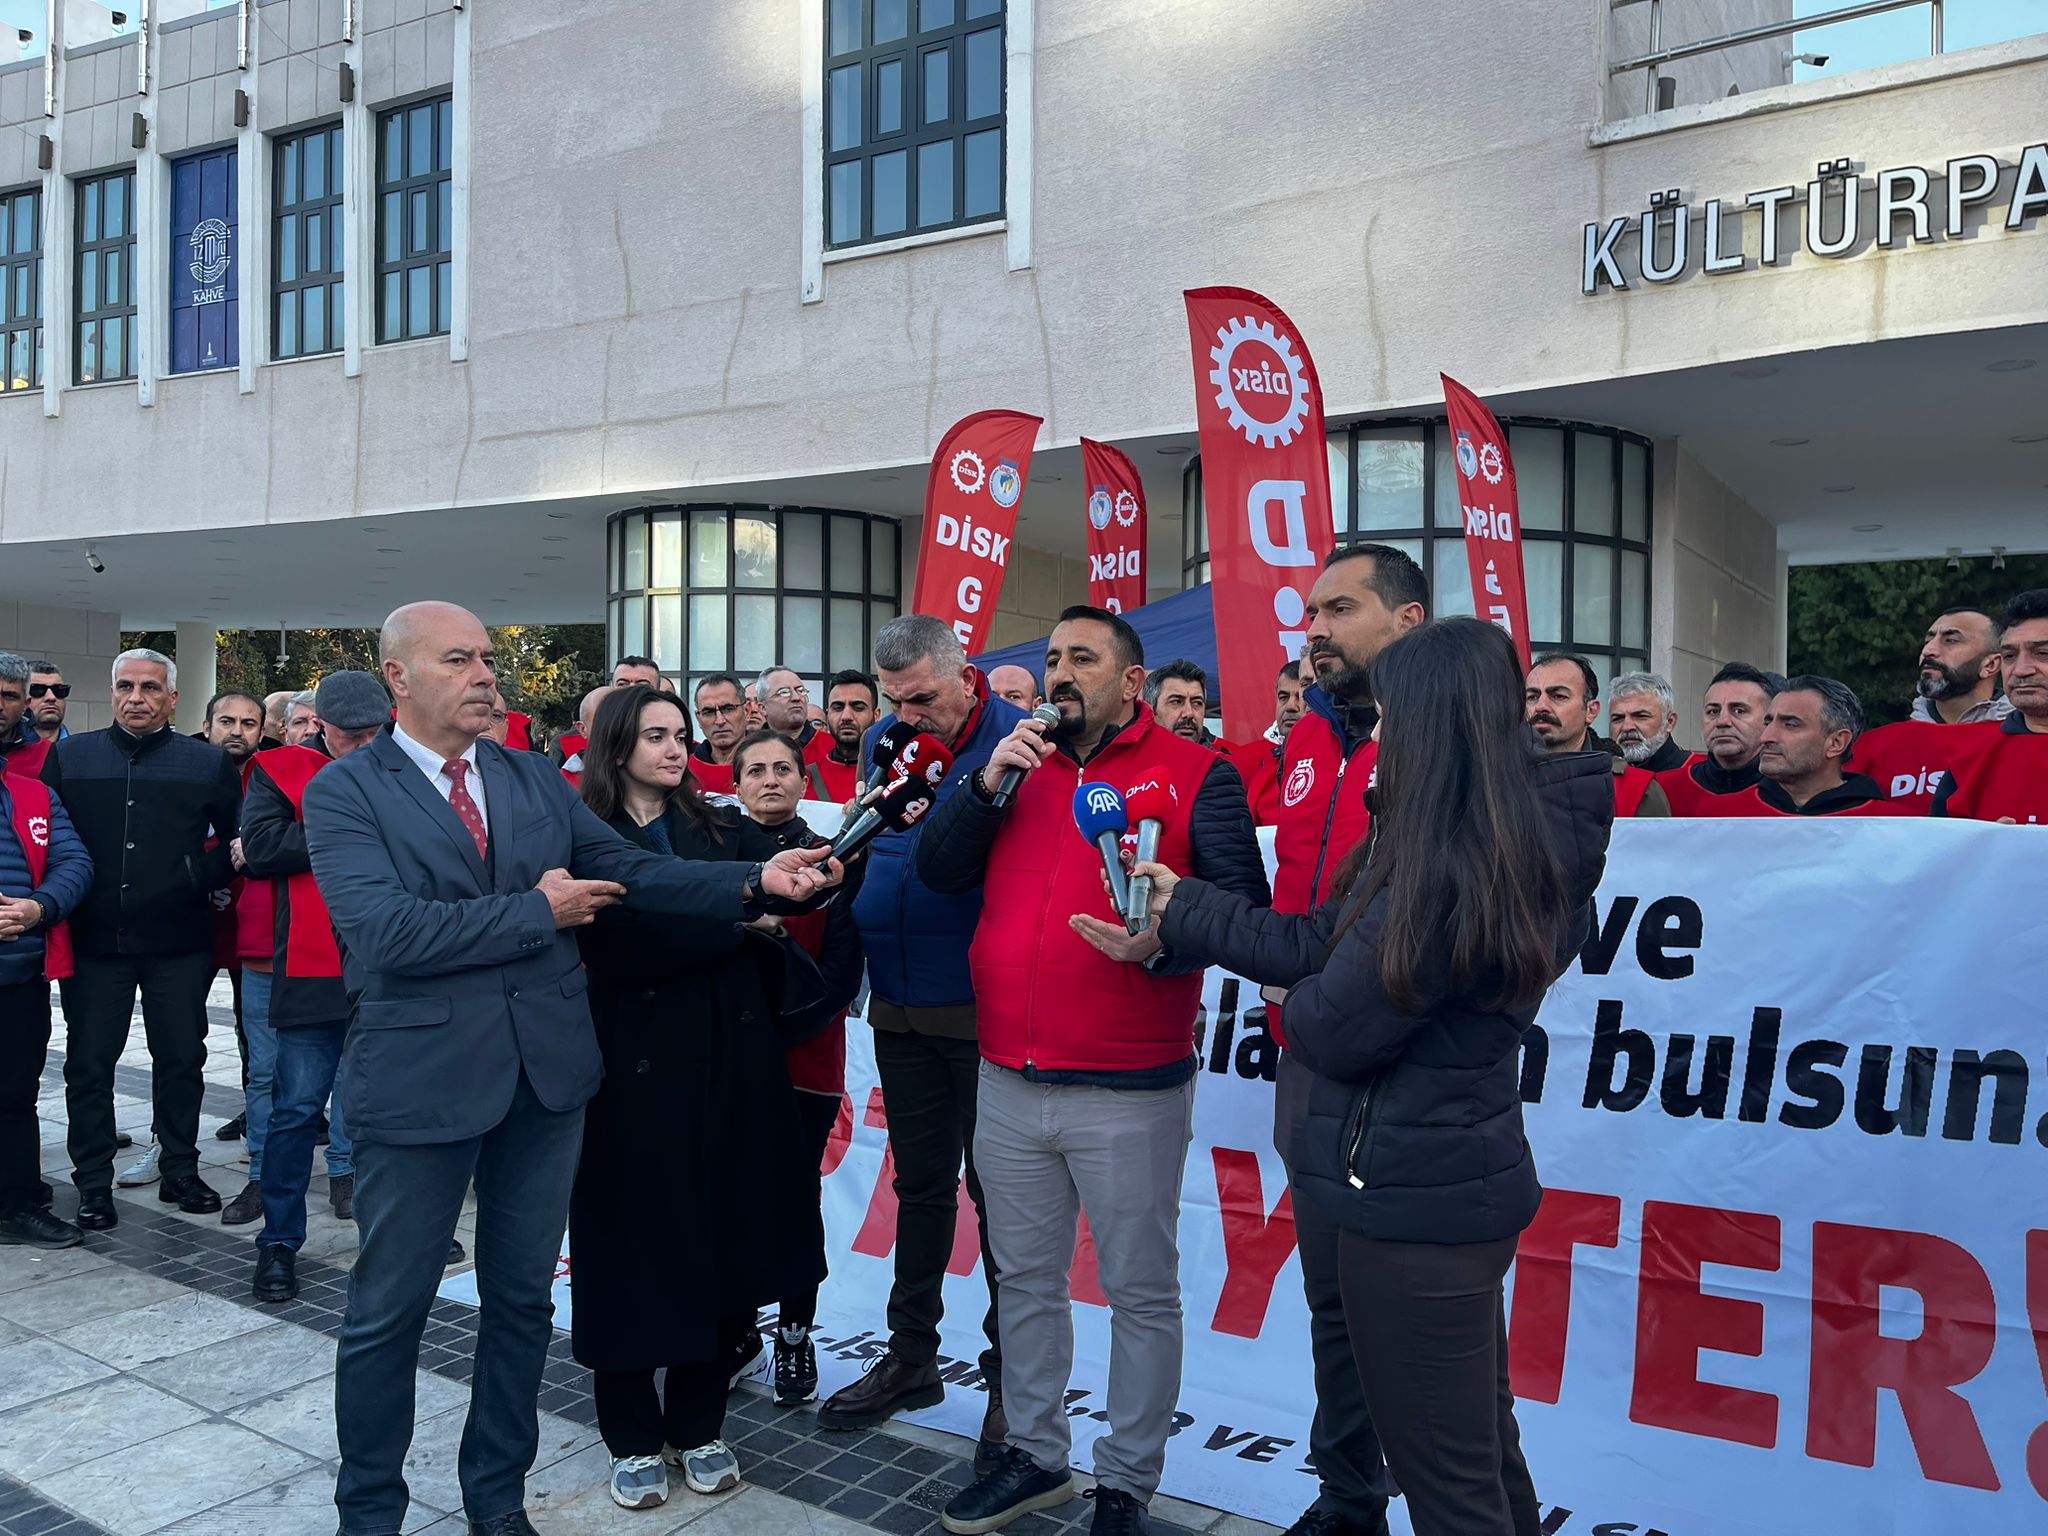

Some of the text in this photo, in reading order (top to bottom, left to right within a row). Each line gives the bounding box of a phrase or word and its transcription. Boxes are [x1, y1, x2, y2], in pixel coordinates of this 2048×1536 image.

[1581, 141, 2048, 297] KÜLTÜRPA
[193, 288, 225, 303] KAHVE
[936, 513, 1010, 567] DİSK
[1891, 766, 1946, 798] DİS
[1091, 792, 1121, 815] AA
[1203, 1424, 1296, 1464] VE
